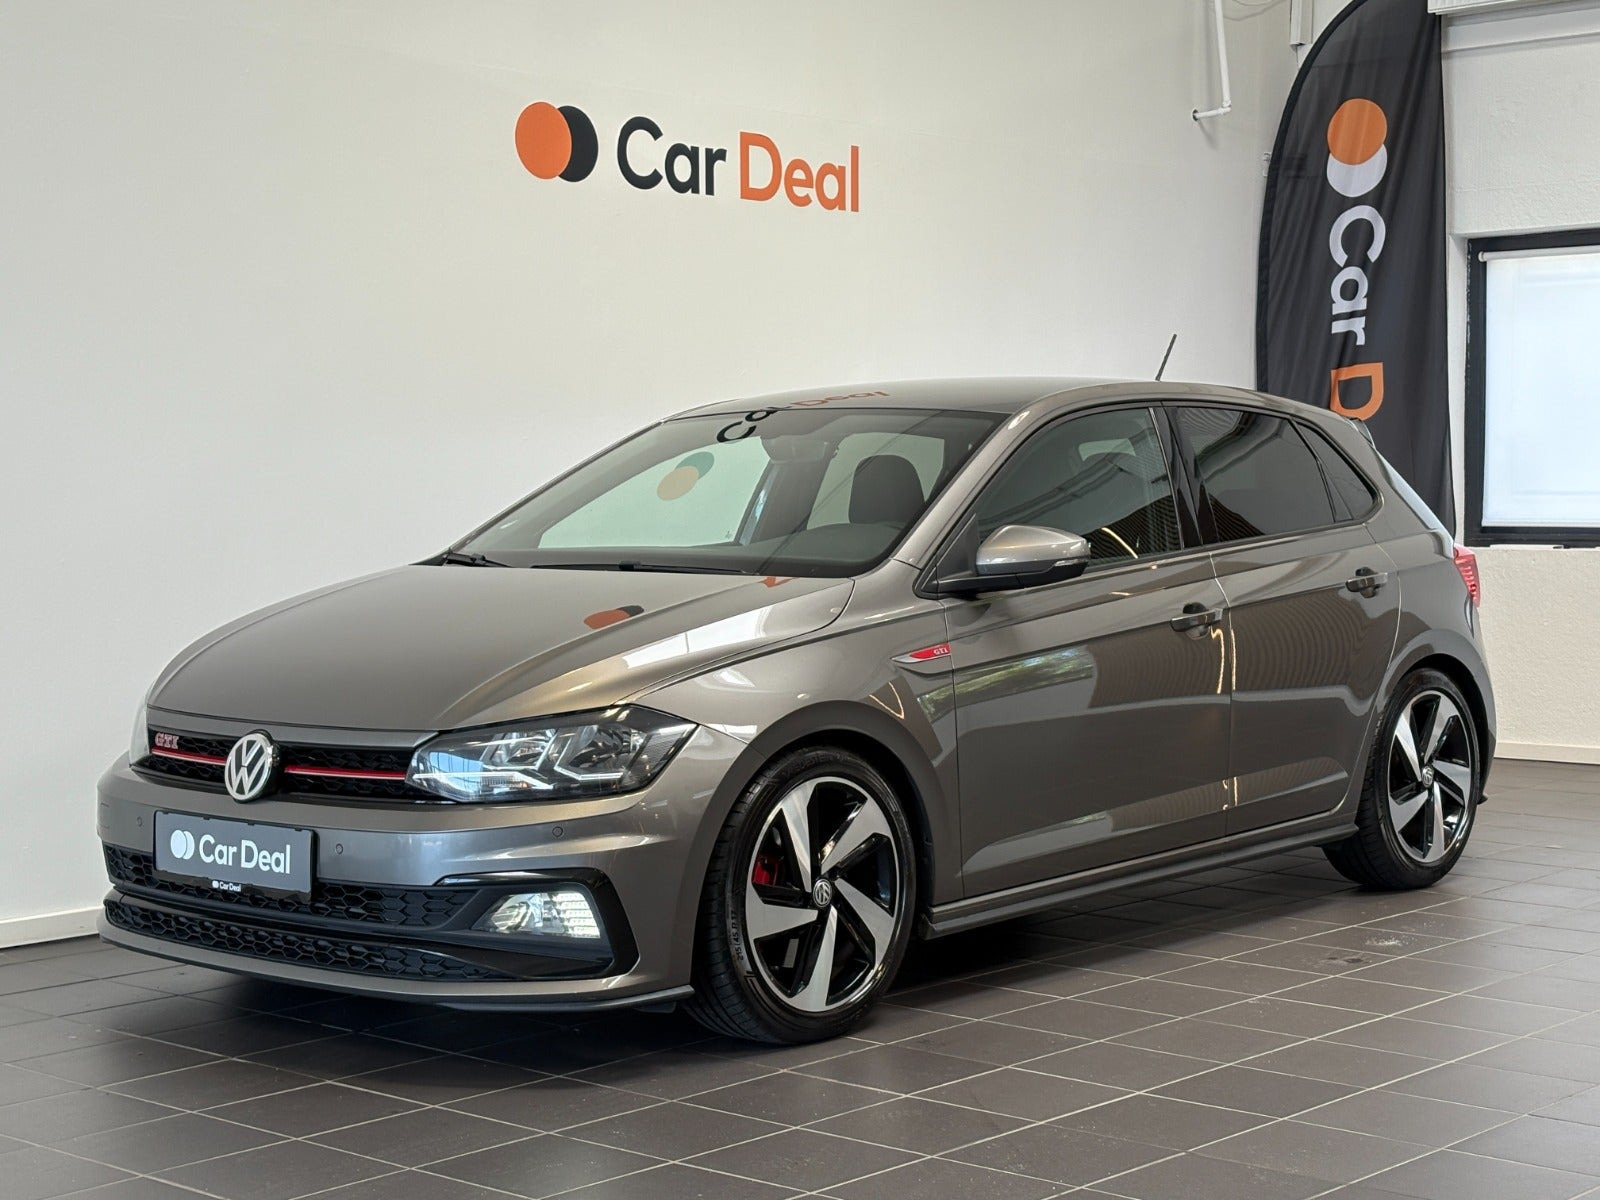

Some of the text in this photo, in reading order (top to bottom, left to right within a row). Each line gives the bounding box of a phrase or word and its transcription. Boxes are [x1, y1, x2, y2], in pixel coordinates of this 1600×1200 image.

[617, 116, 860, 212] Car Deal
[1329, 205, 1386, 346] Car
[933, 647, 949, 656] GTI
[155, 733, 179, 749] GTI
[199, 834, 291, 874] Car Deal
